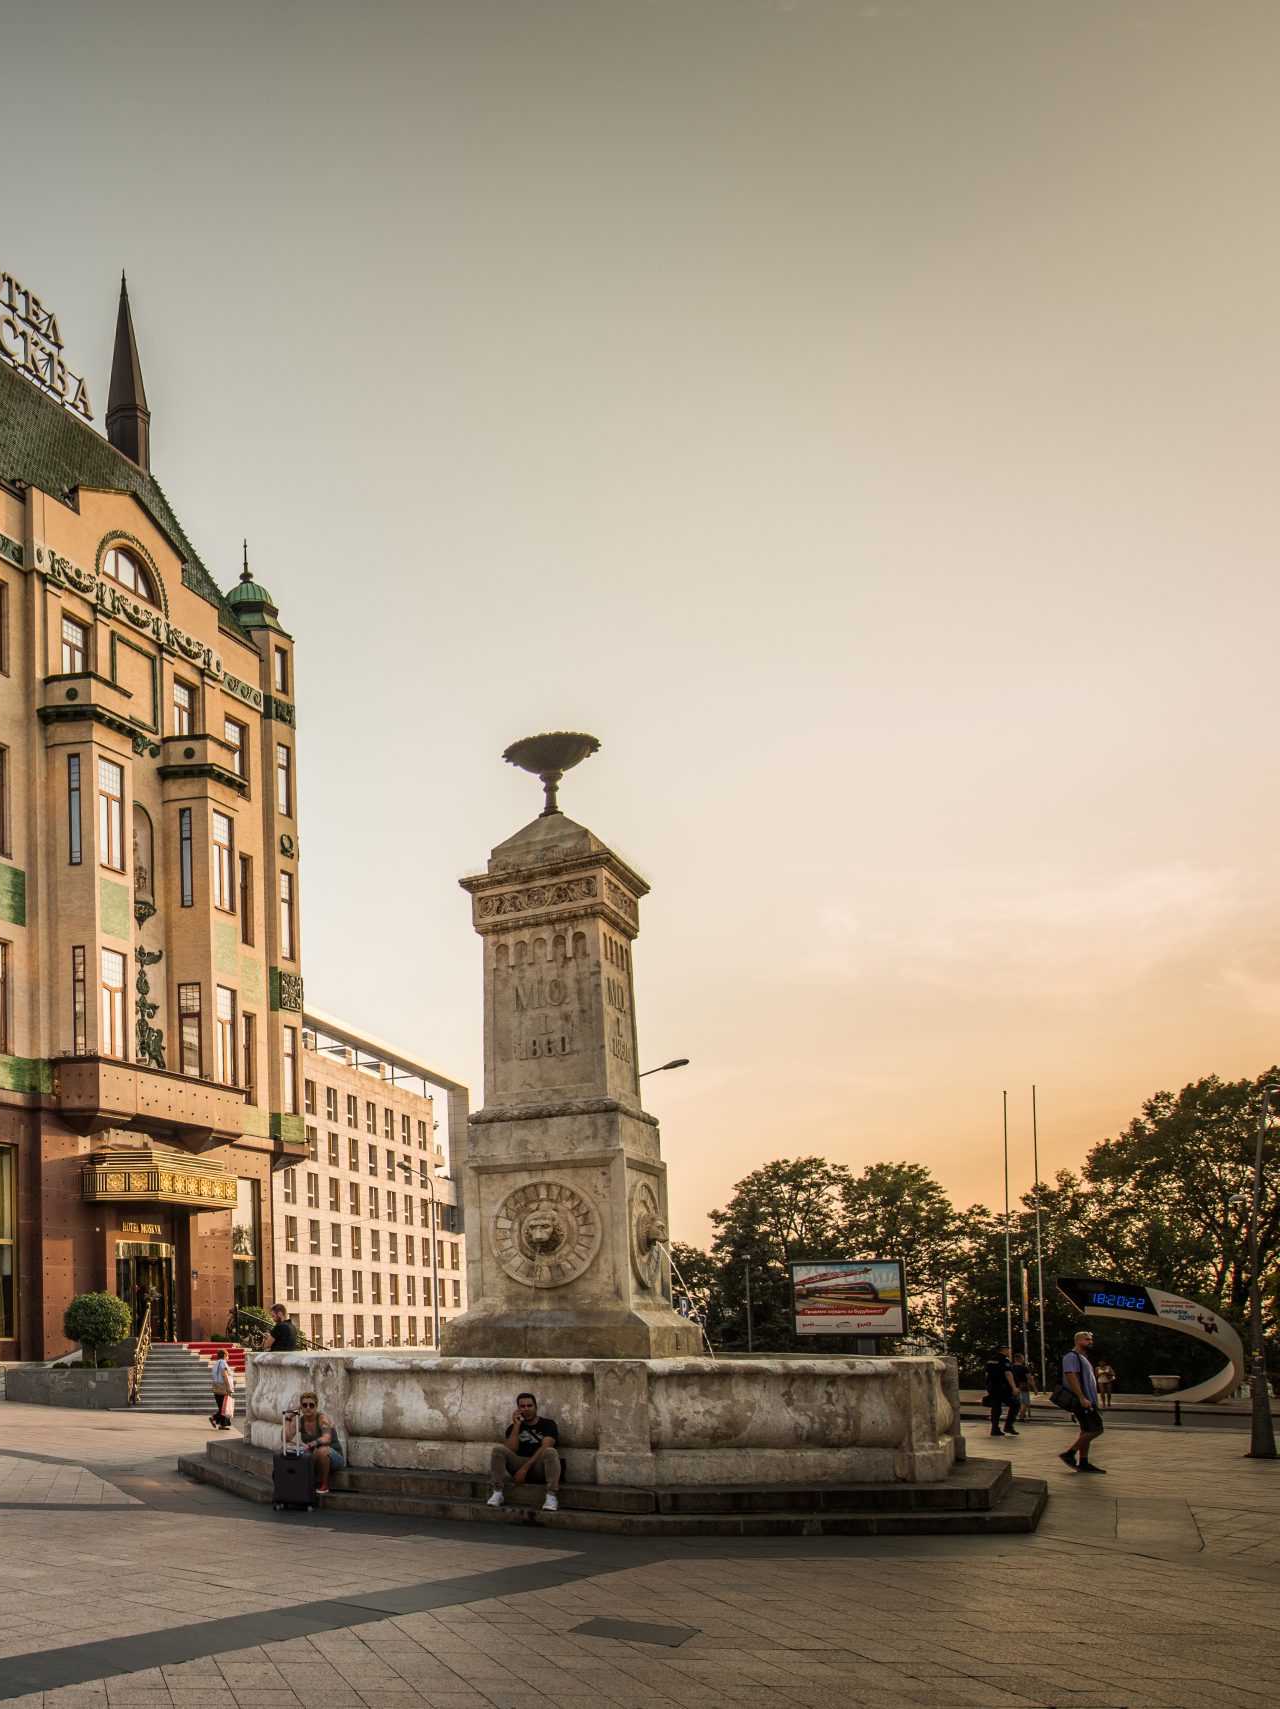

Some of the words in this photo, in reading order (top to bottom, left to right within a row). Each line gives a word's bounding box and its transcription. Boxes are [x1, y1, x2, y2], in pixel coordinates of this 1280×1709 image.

[122, 1221, 140, 1233] HOTEL
[140, 1223, 162, 1235] MOSKVA
[1091, 1293, 1145, 1310] 18:20:22
